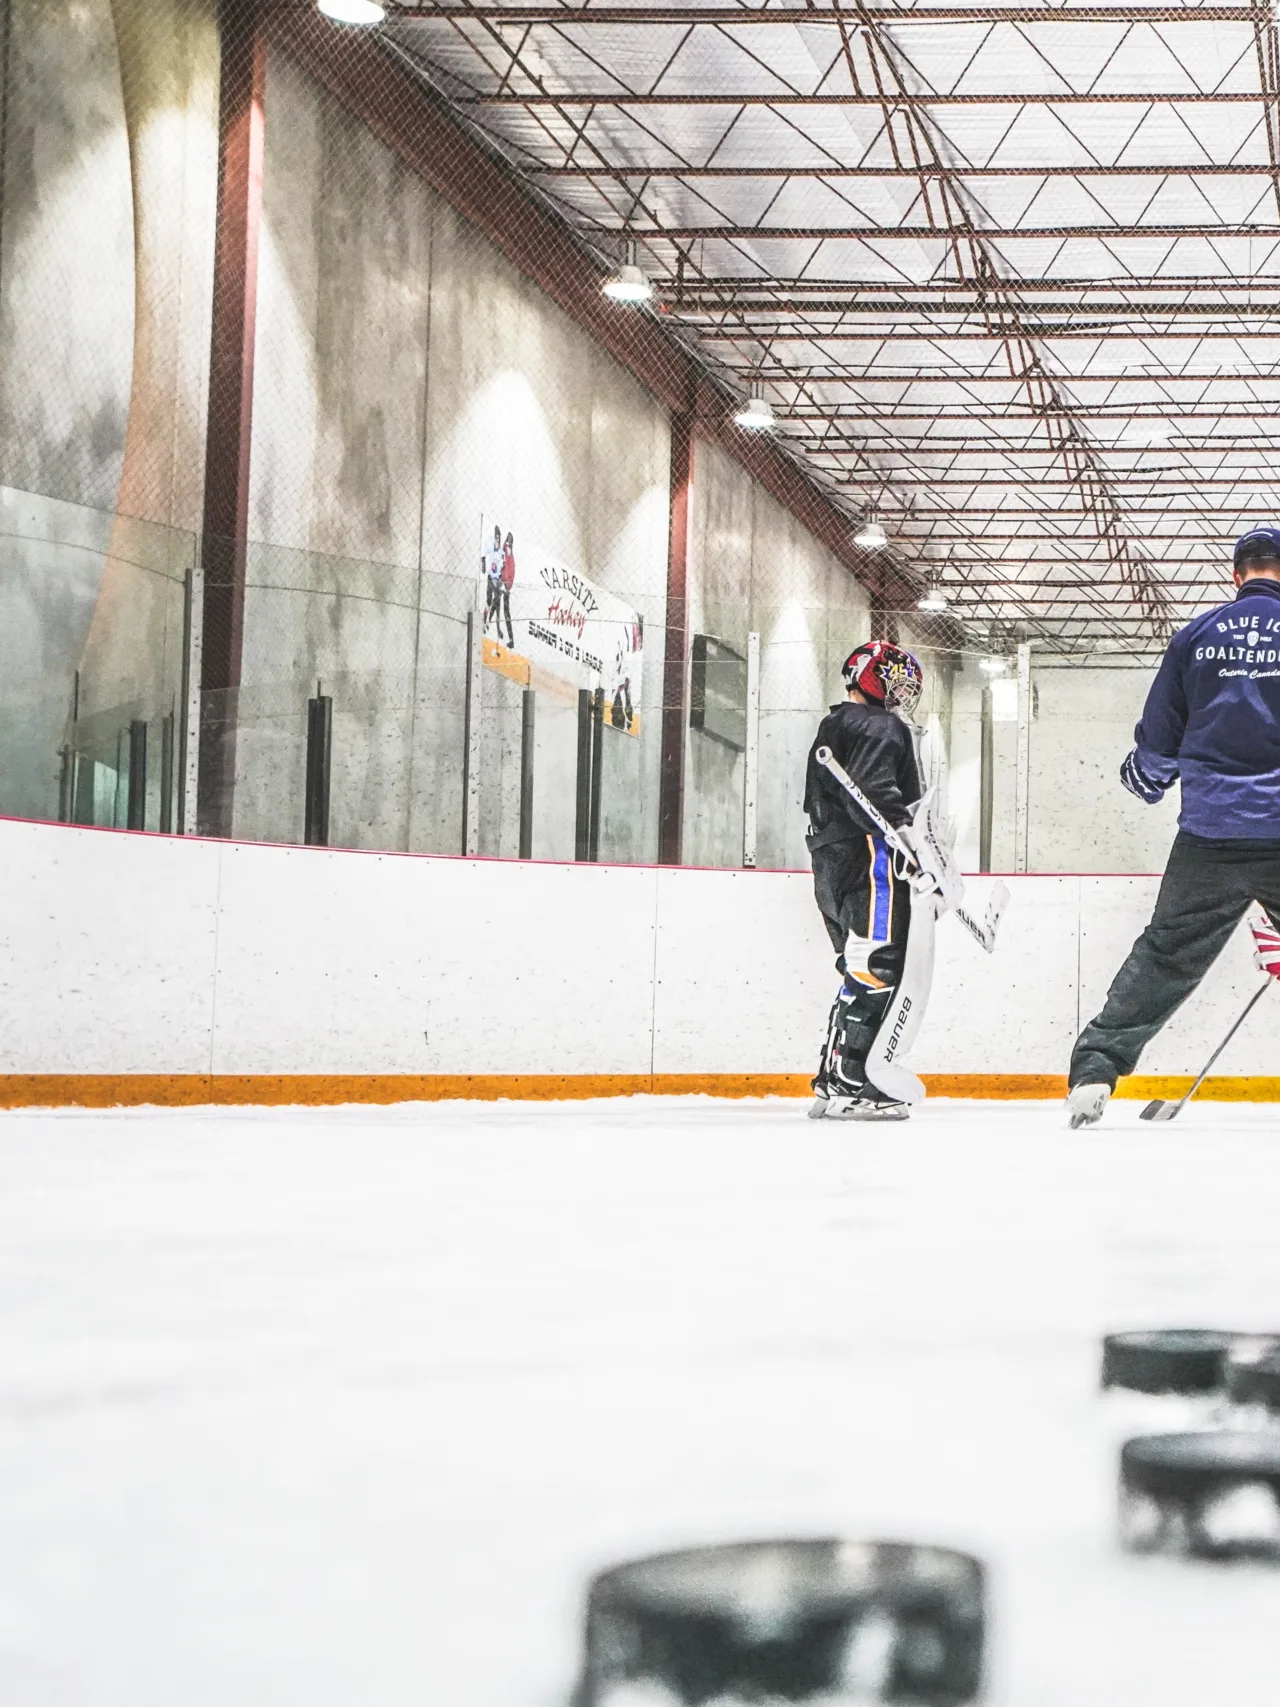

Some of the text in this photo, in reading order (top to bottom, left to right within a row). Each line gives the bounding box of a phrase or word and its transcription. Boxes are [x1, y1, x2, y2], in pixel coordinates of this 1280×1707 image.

[540, 567, 598, 614] VARSITY
[547, 596, 585, 640] Hockey
[1216, 616, 1260, 633] BLUE
[1218, 668, 1280, 679] Ontario Canada
